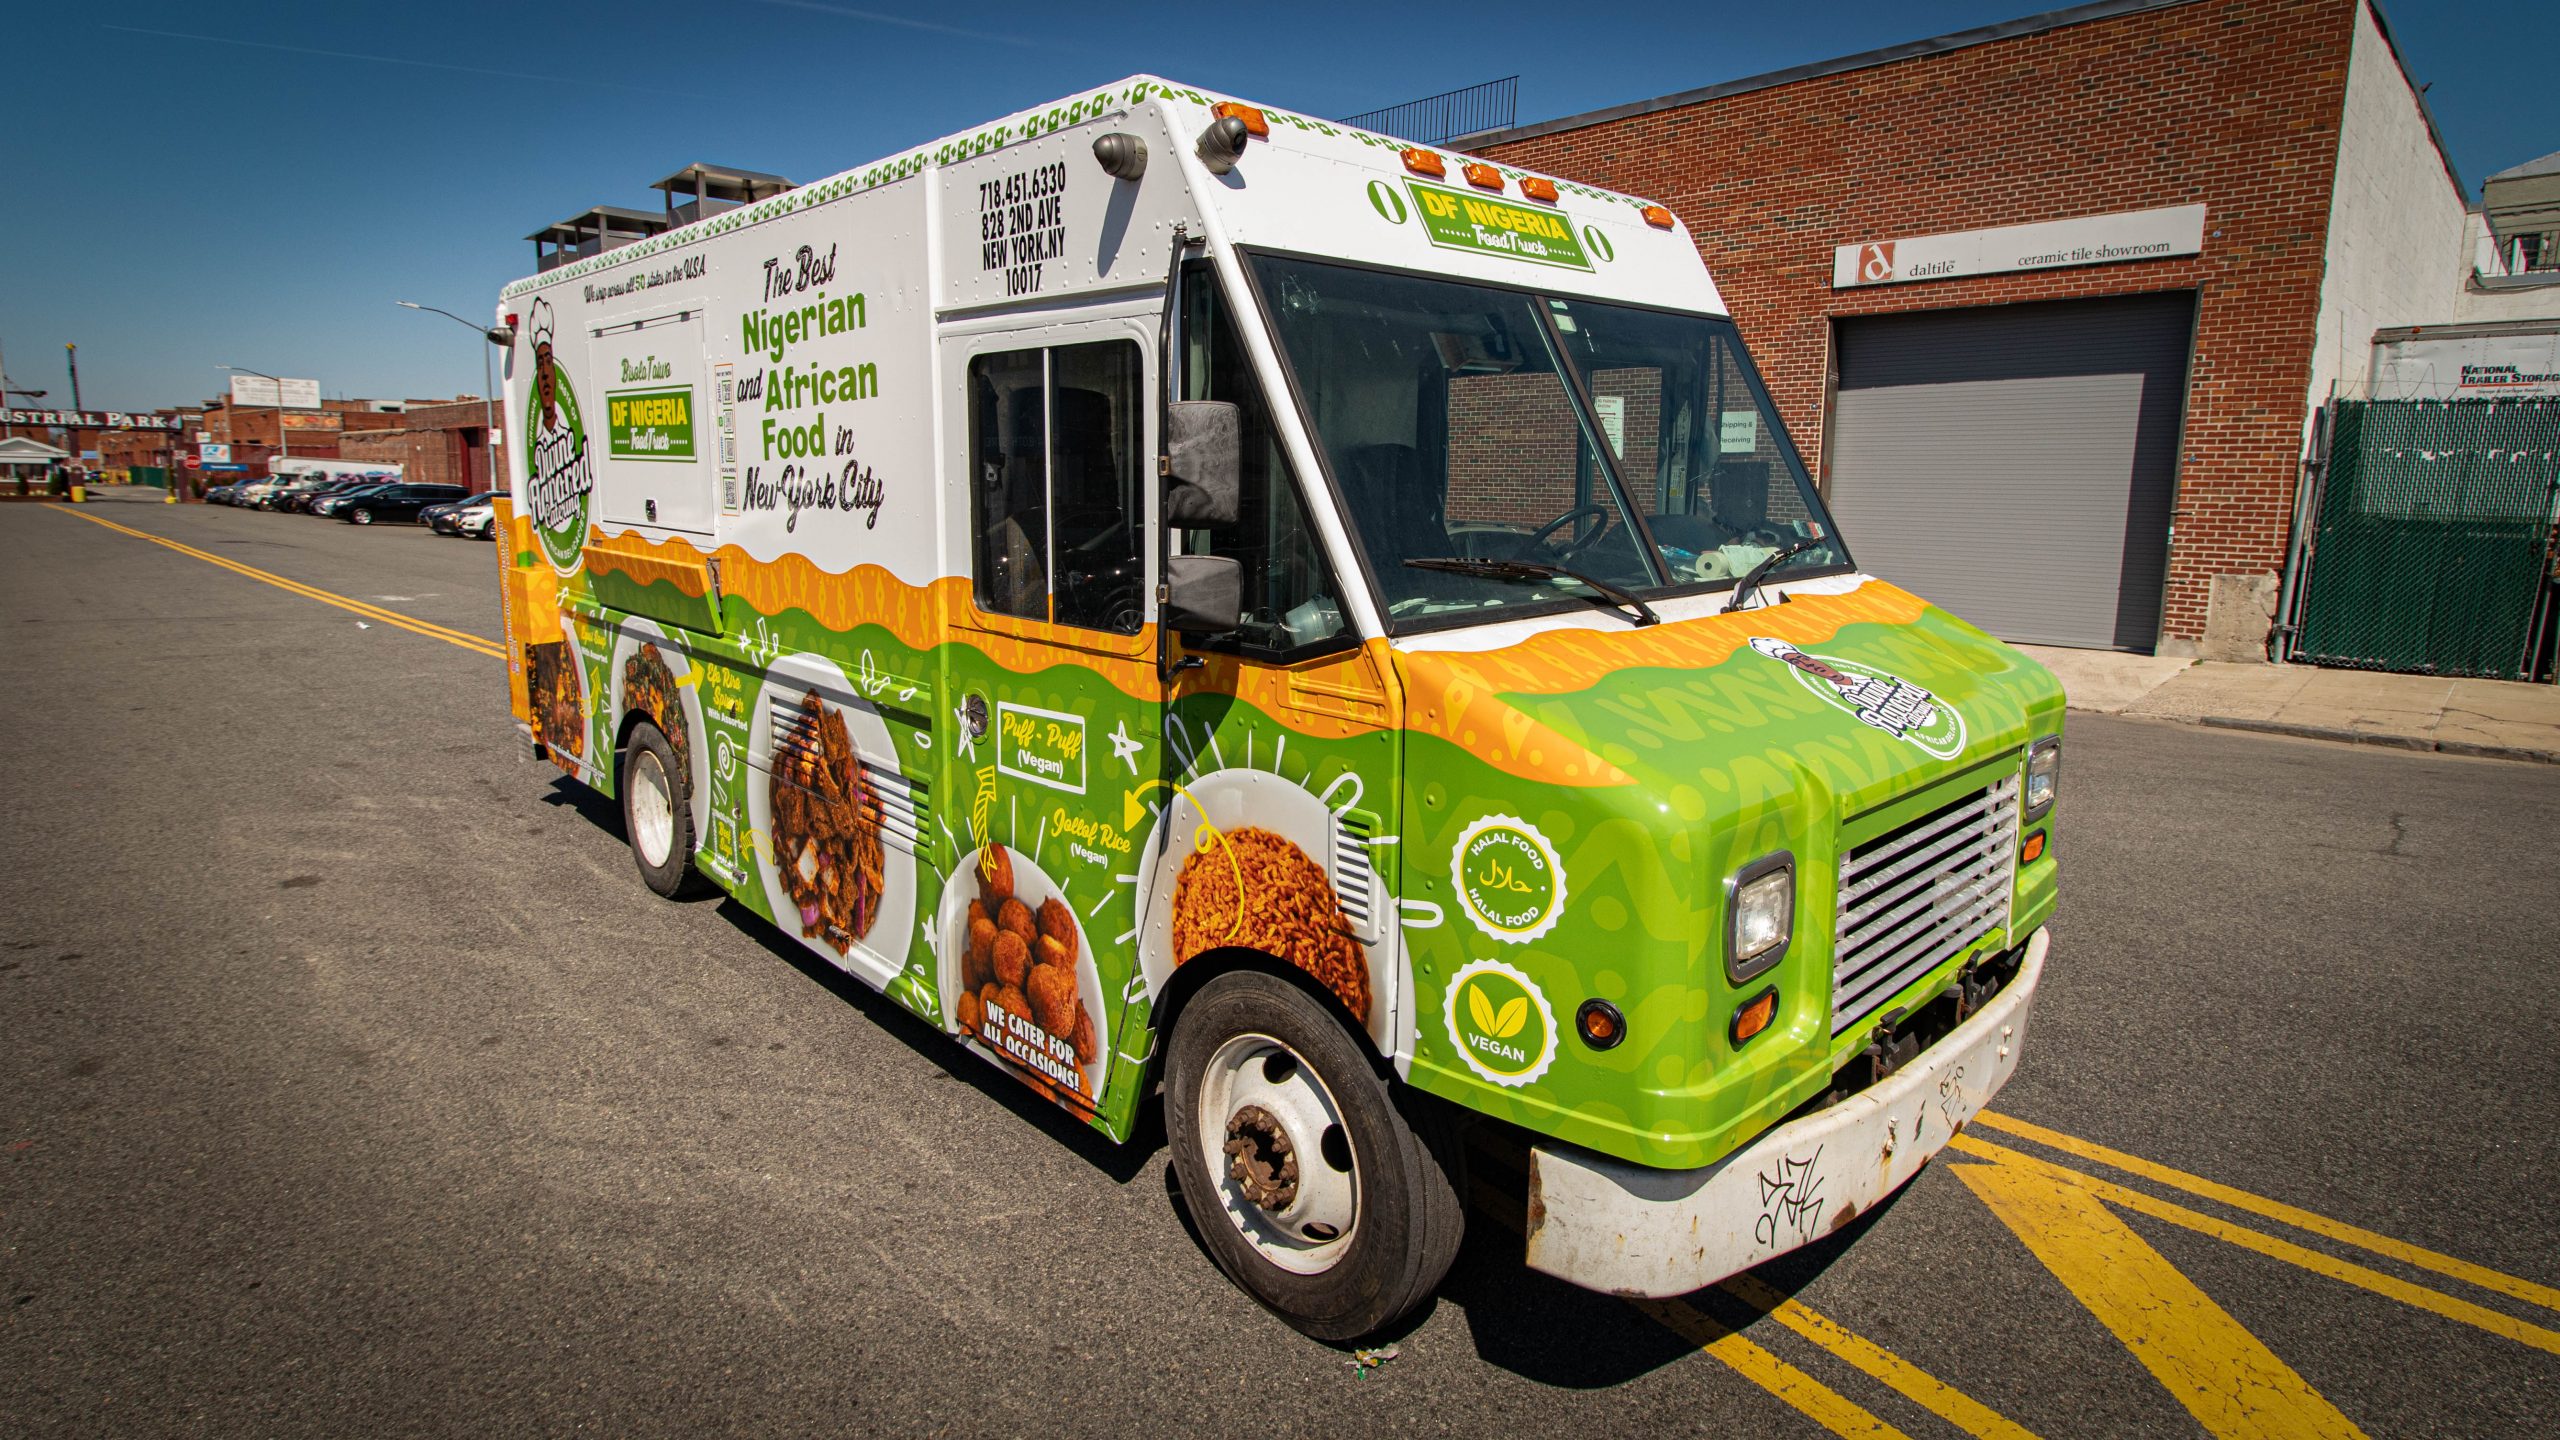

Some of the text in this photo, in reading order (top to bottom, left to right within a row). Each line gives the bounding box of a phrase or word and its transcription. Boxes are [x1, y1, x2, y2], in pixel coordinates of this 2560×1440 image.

[980, 161, 1066, 212] 718.451.6330
[982, 195, 1061, 241] 828 2ND AVE
[1420, 190, 1570, 242] DF NIGERIA
[763, 242, 837, 303] The Best
[983, 239, 1008, 271] NEW
[2018, 249, 2069, 266] ceramic
[2071, 246, 2092, 262] tile
[2095, 241, 2171, 259] showroom
[635, 274, 645, 291] 50
[1006, 263, 1042, 296] 10017
[743, 291, 867, 363] Nigerian
[737, 362, 879, 413] and African
[611, 398, 688, 427] DF NIGERIA
[762, 412, 854, 461] Food in
[743, 459, 884, 533] New York City
[1003, 711, 1036, 748] Puff
[1047, 723, 1082, 760] Puff
[1017, 748, 1064, 780] (Vegan)
[1051, 807, 1132, 853] Jollof Rice
[1471, 832, 1544, 870] HALAL FOOD
[1070, 842, 1108, 869] (Vegan)
[1468, 887, 1539, 927] HALAL FOOD
[986, 1000, 1075, 1067] WE CATER FOR
[1468, 1032, 1525, 1063] VEGAN
[983, 1022, 1080, 1092] ALL OCCASIONS!
